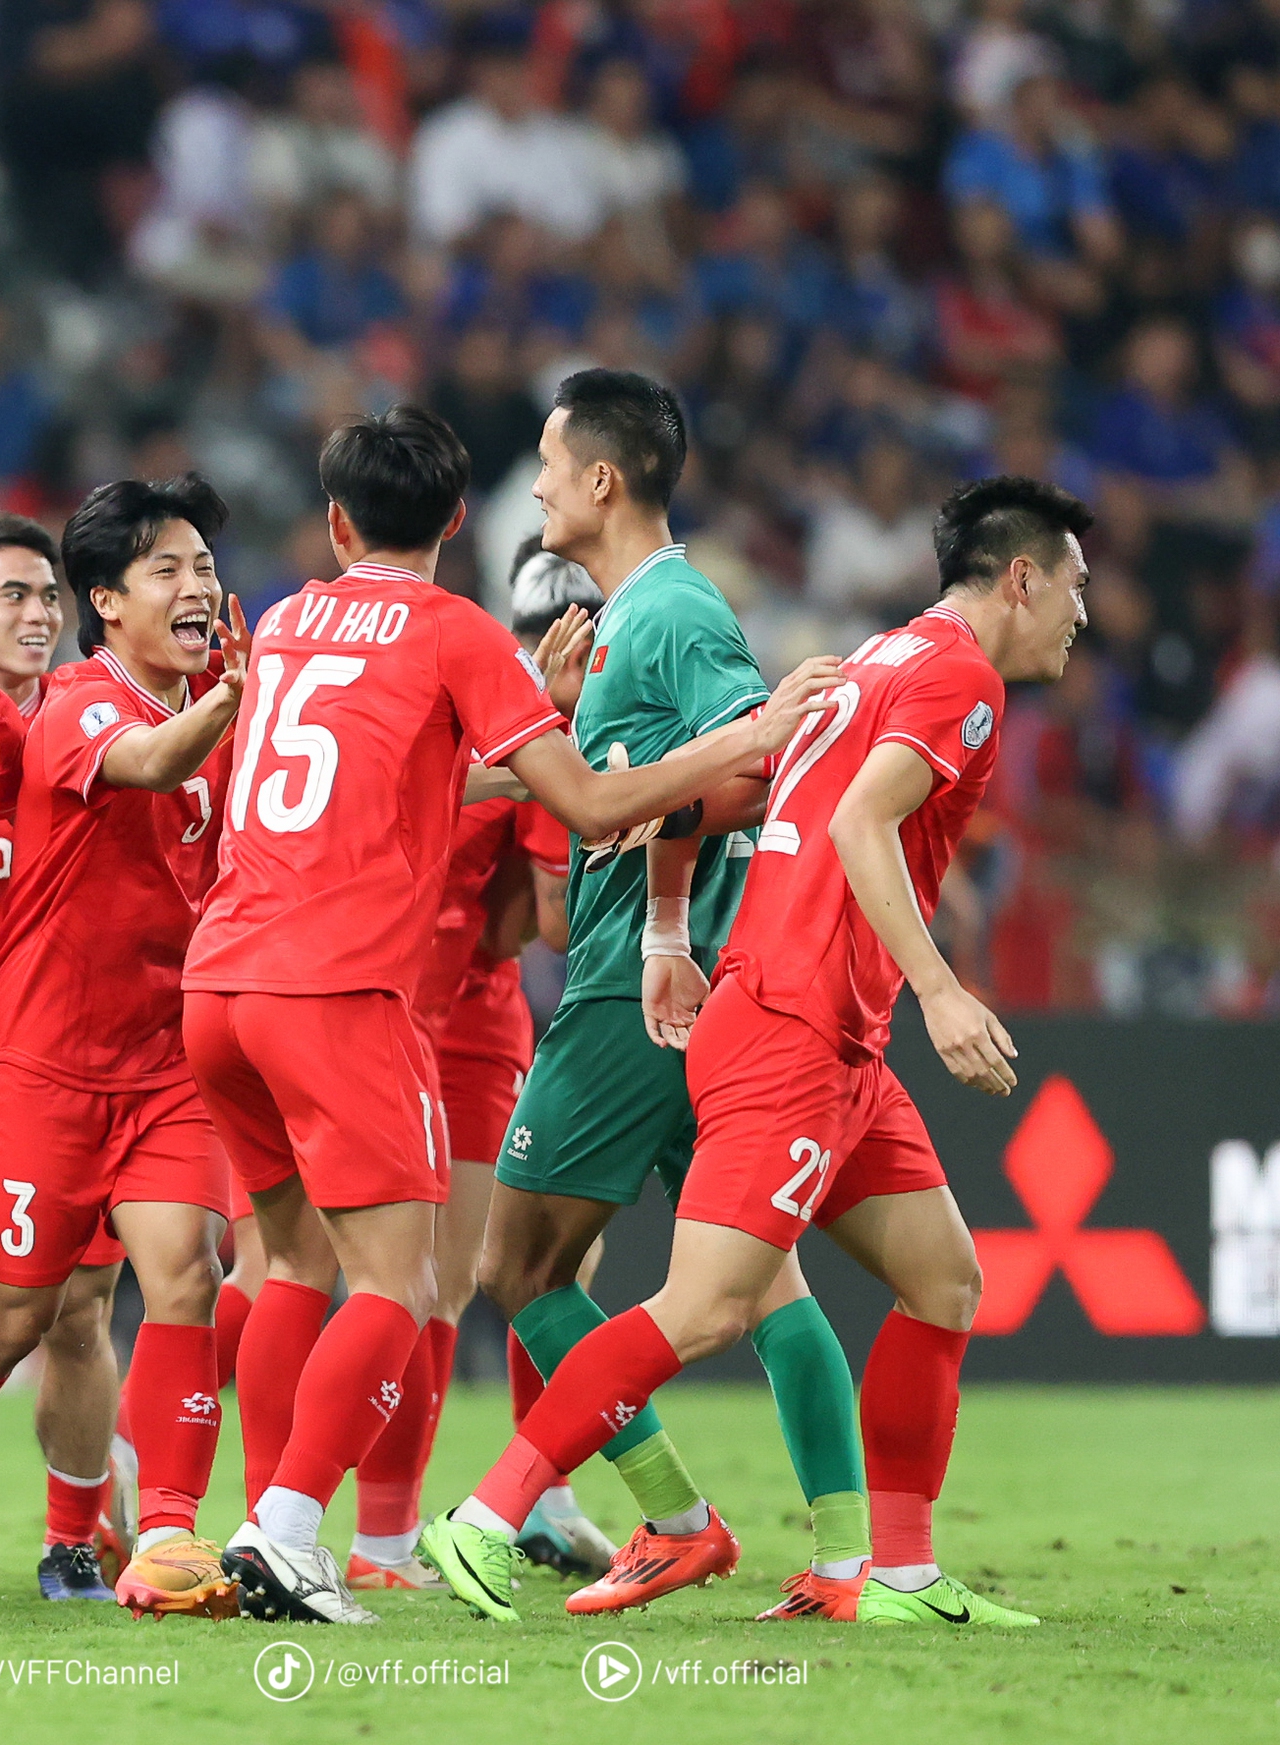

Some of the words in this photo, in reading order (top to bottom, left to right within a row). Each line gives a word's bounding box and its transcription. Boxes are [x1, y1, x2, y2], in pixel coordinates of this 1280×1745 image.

[295, 593, 338, 640] VI
[331, 601, 410, 645] HAO
[230, 653, 367, 832] 15
[0, 1178, 37, 1257] 3
[770, 1136, 832, 1222] 22
